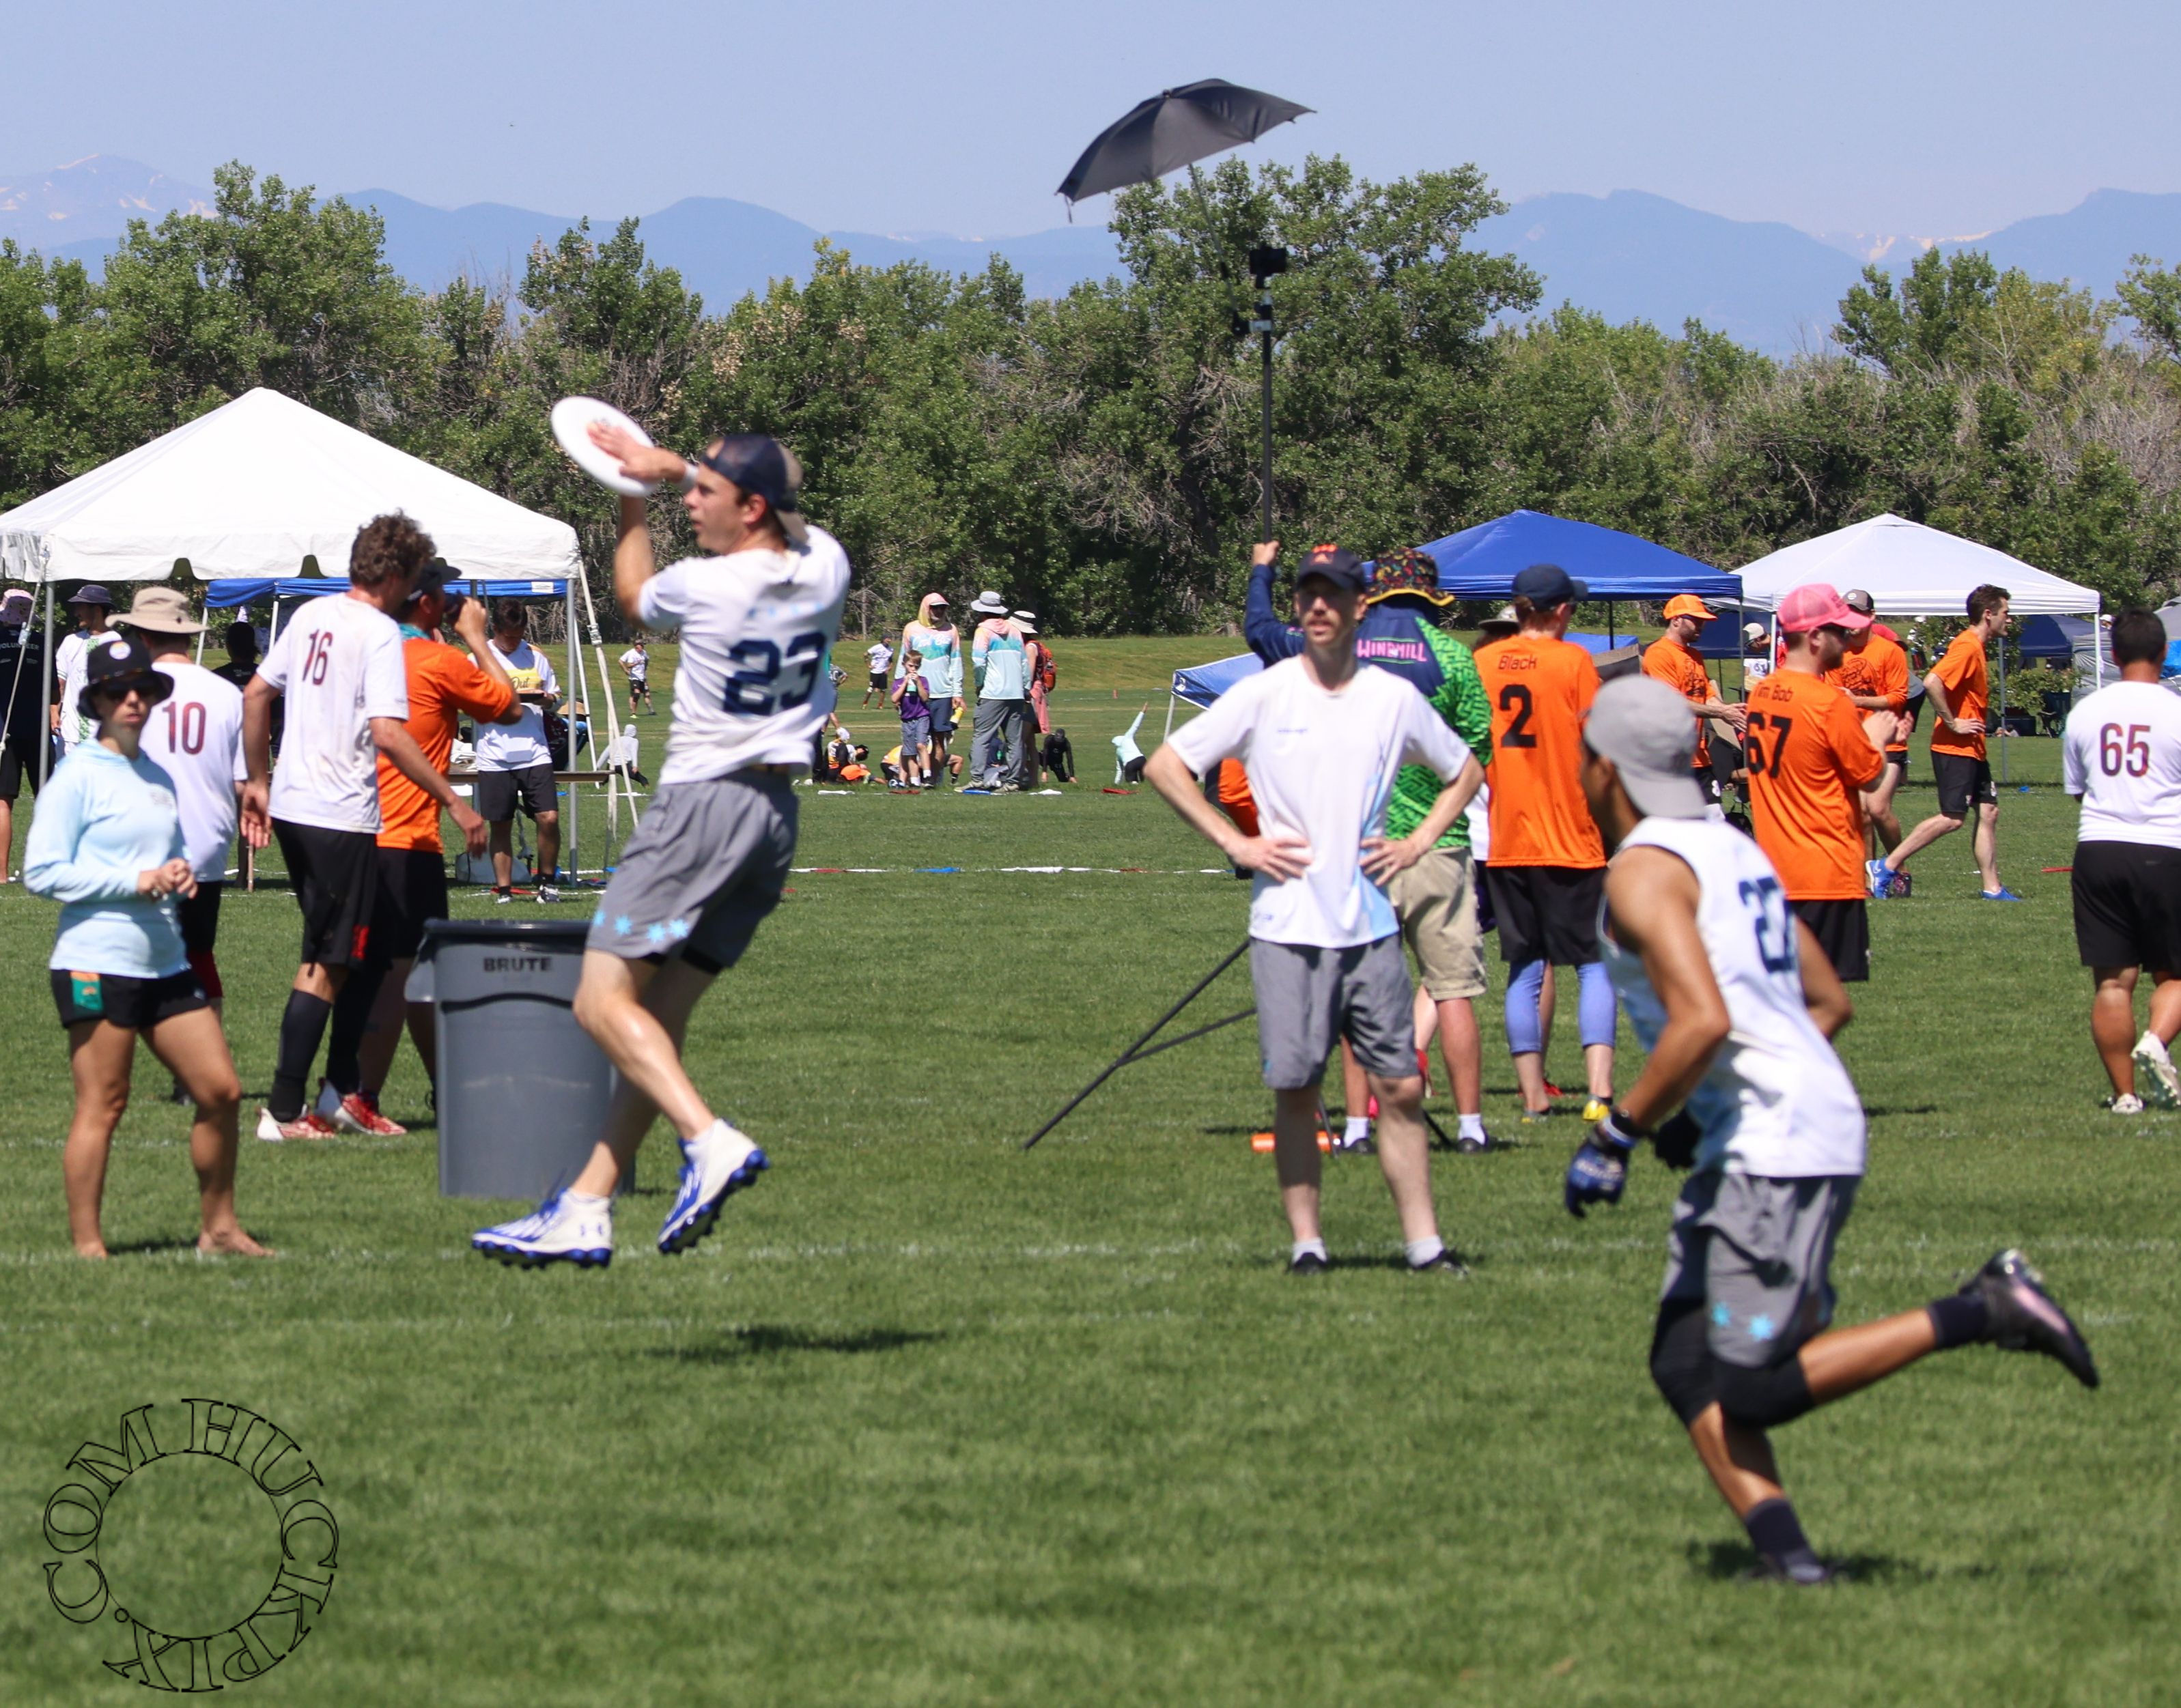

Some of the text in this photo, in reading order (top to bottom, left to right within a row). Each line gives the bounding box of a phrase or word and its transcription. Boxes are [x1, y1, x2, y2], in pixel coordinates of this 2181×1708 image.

[302, 628, 333, 685] 16
[722, 631, 827, 715] 23
[162, 701, 206, 755] 10
[1500, 684, 1536, 748] 2
[1747, 712, 1792, 778] 67
[2100, 722, 2151, 778] 65
[483, 958, 552, 972] BRUTE
